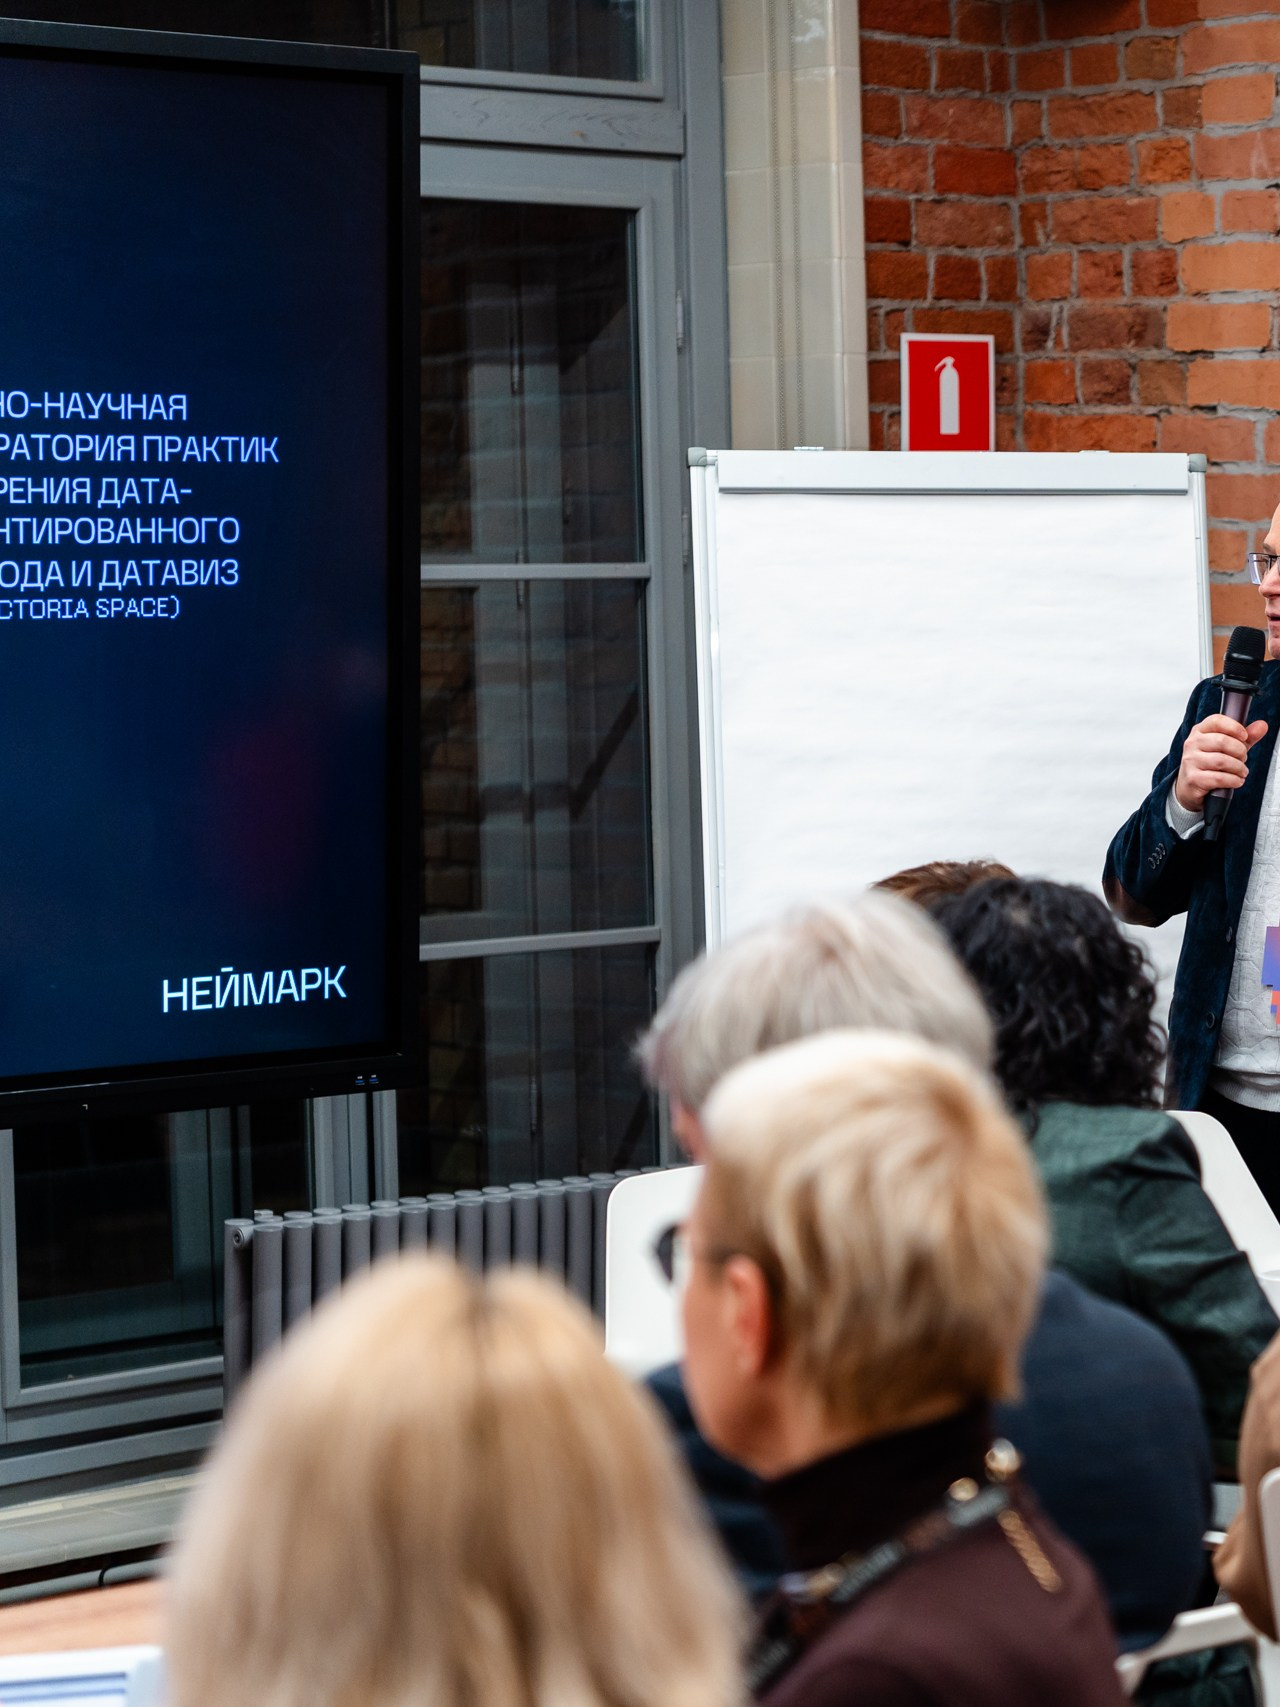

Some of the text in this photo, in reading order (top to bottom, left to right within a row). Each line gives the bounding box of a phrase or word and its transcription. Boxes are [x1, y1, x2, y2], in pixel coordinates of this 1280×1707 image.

[0, 391, 187, 420] О-НАУЧНАЯ
[143, 436, 279, 462] ПРАКТИК
[97, 478, 192, 508] ДАТА-
[0, 558, 239, 592] ОДА И ДАТАВИЗ
[96, 595, 180, 618] SPACE)
[162, 965, 347, 1013] НЕЙМАРК
